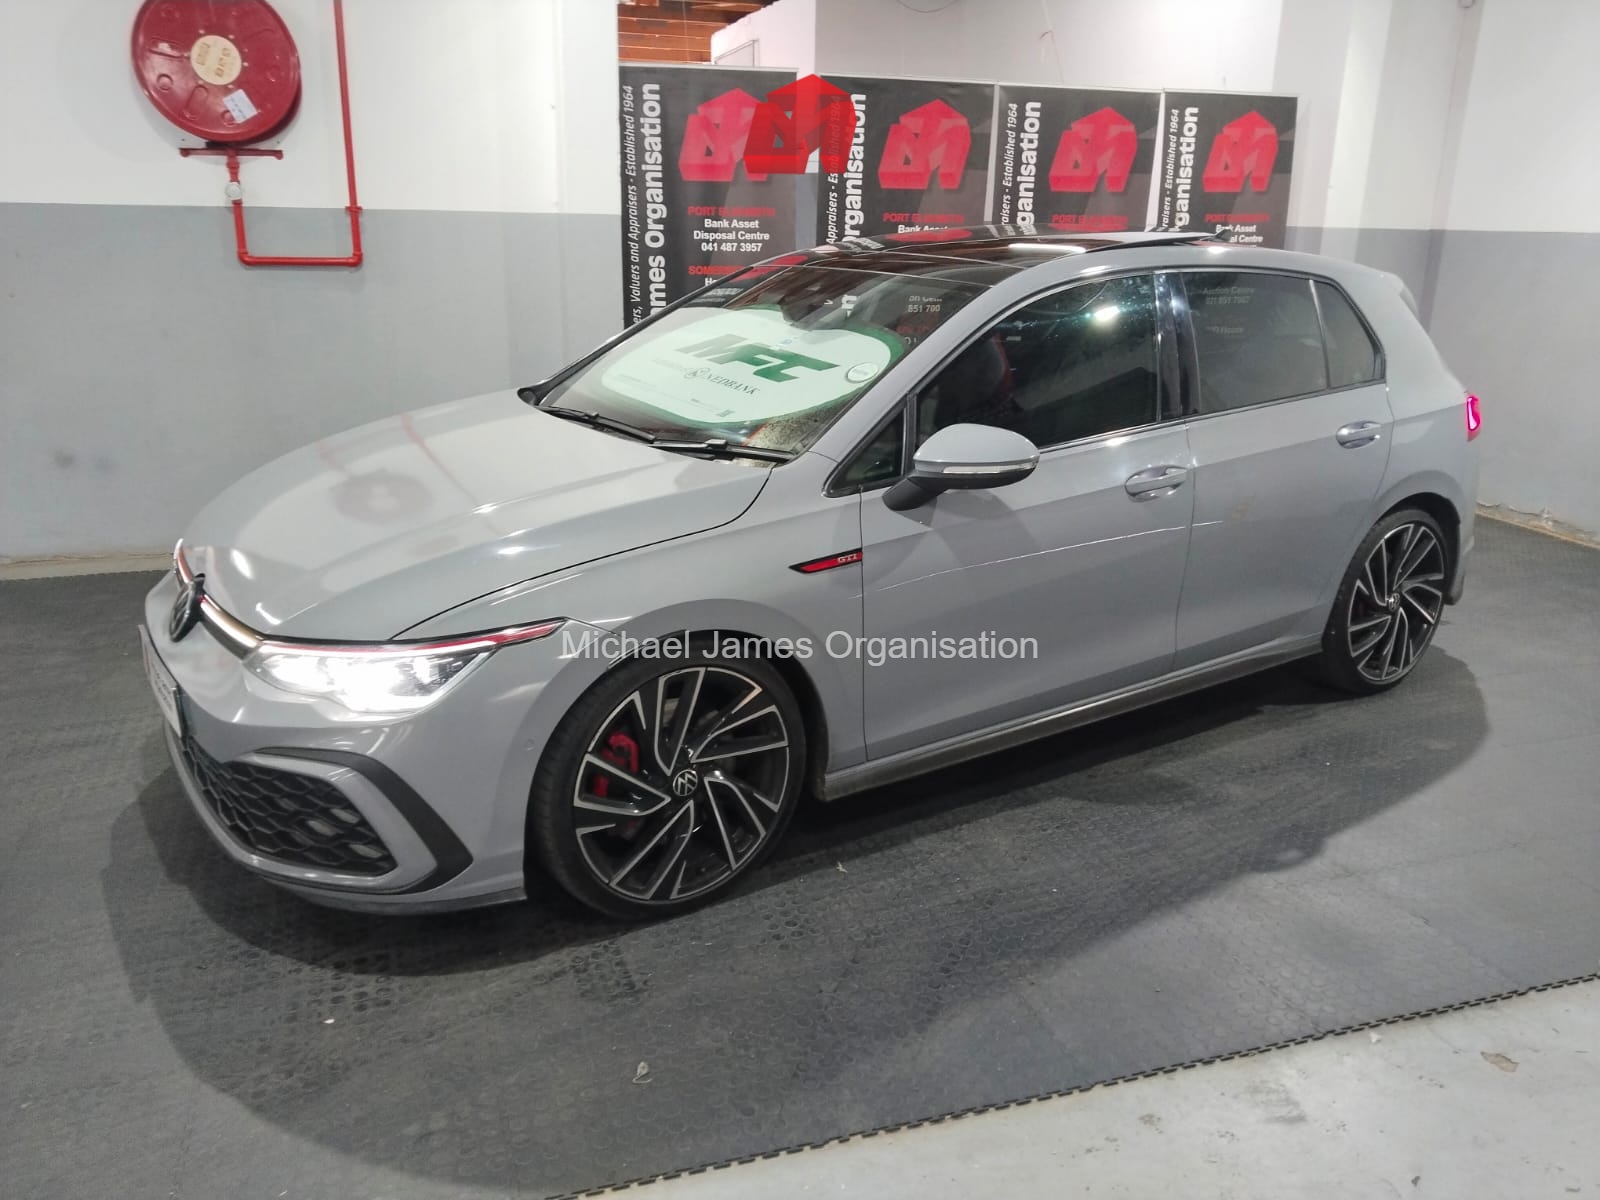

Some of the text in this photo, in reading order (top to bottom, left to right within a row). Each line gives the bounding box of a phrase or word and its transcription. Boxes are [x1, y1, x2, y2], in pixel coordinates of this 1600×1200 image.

[622, 85, 634, 112] 1964
[1007, 103, 1018, 128] 1964
[1170, 109, 1180, 132] 1964
[623, 114, 637, 176] Established
[1002, 130, 1016, 187] Established
[1016, 101, 1042, 227] ganisation
[1164, 134, 1178, 190] Established
[1174, 106, 1199, 229] ganisation
[627, 185, 640, 240] Appraisers
[640, 83, 667, 315] mes Organisation
[1000, 194, 1011, 226] raisers
[1161, 196, 1172, 228] raisers
[704, 219, 759, 228] Bank Asset
[825, 191, 838, 244] Appraisers
[897, 225, 922, 233] Bank
[693, 230, 770, 241] Disposal Centre
[701, 243, 763, 251] 041 487 3957
[628, 241, 640, 263] and
[629, 264, 640, 302] Valuers
[926, 304, 941, 312] 700
[838, 553, 857, 563] GTI
